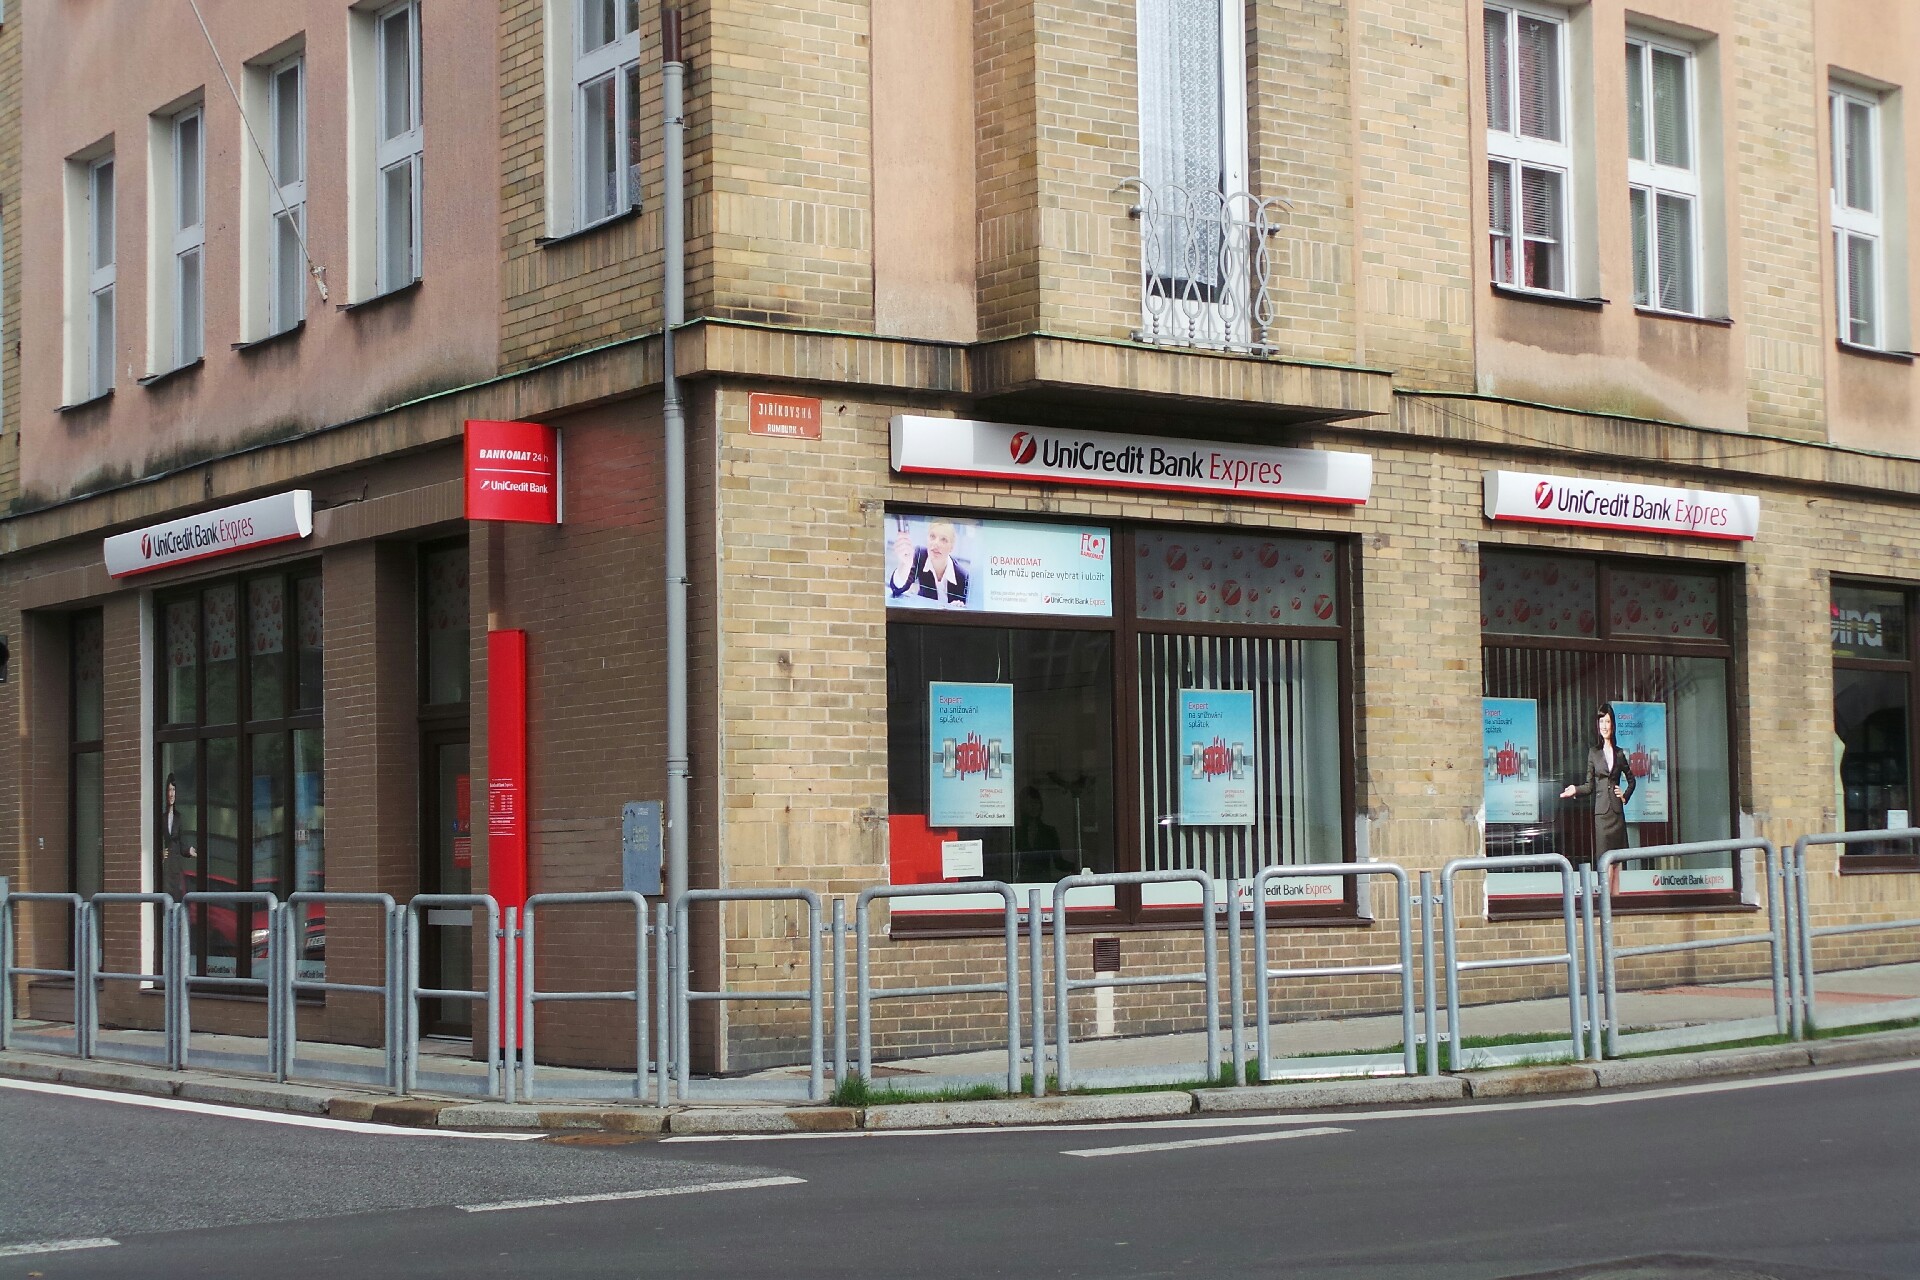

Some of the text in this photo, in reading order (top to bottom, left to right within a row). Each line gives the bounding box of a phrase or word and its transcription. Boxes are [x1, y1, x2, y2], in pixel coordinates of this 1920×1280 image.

[479, 449, 532, 461] BANKOMAT
[532, 452, 542, 462] 24
[1043, 438, 1282, 488] UniCredit Bank Expres
[490, 480, 548, 494] UniCredit Bank
[1557, 487, 1728, 530] UniCredit Bank Expres
[153, 517, 254, 558] UniCredit Bank Expres
[990, 556, 1042, 567] iQ BANKOMAT
[990, 568, 1007, 578] tady
[1031, 569, 1055, 579] peníze
[1056, 571, 1079, 581] vybrat
[1085, 572, 1105, 581] uložit
[1075, 597, 1089, 605] Bank
[939, 695, 962, 706] Expert
[1188, 701, 1209, 711] Expert
[1660, 875, 1725, 886] UniCredit Bank Expres
[1283, 884, 1305, 896] Bank
[1305, 883, 1332, 898] Expres
